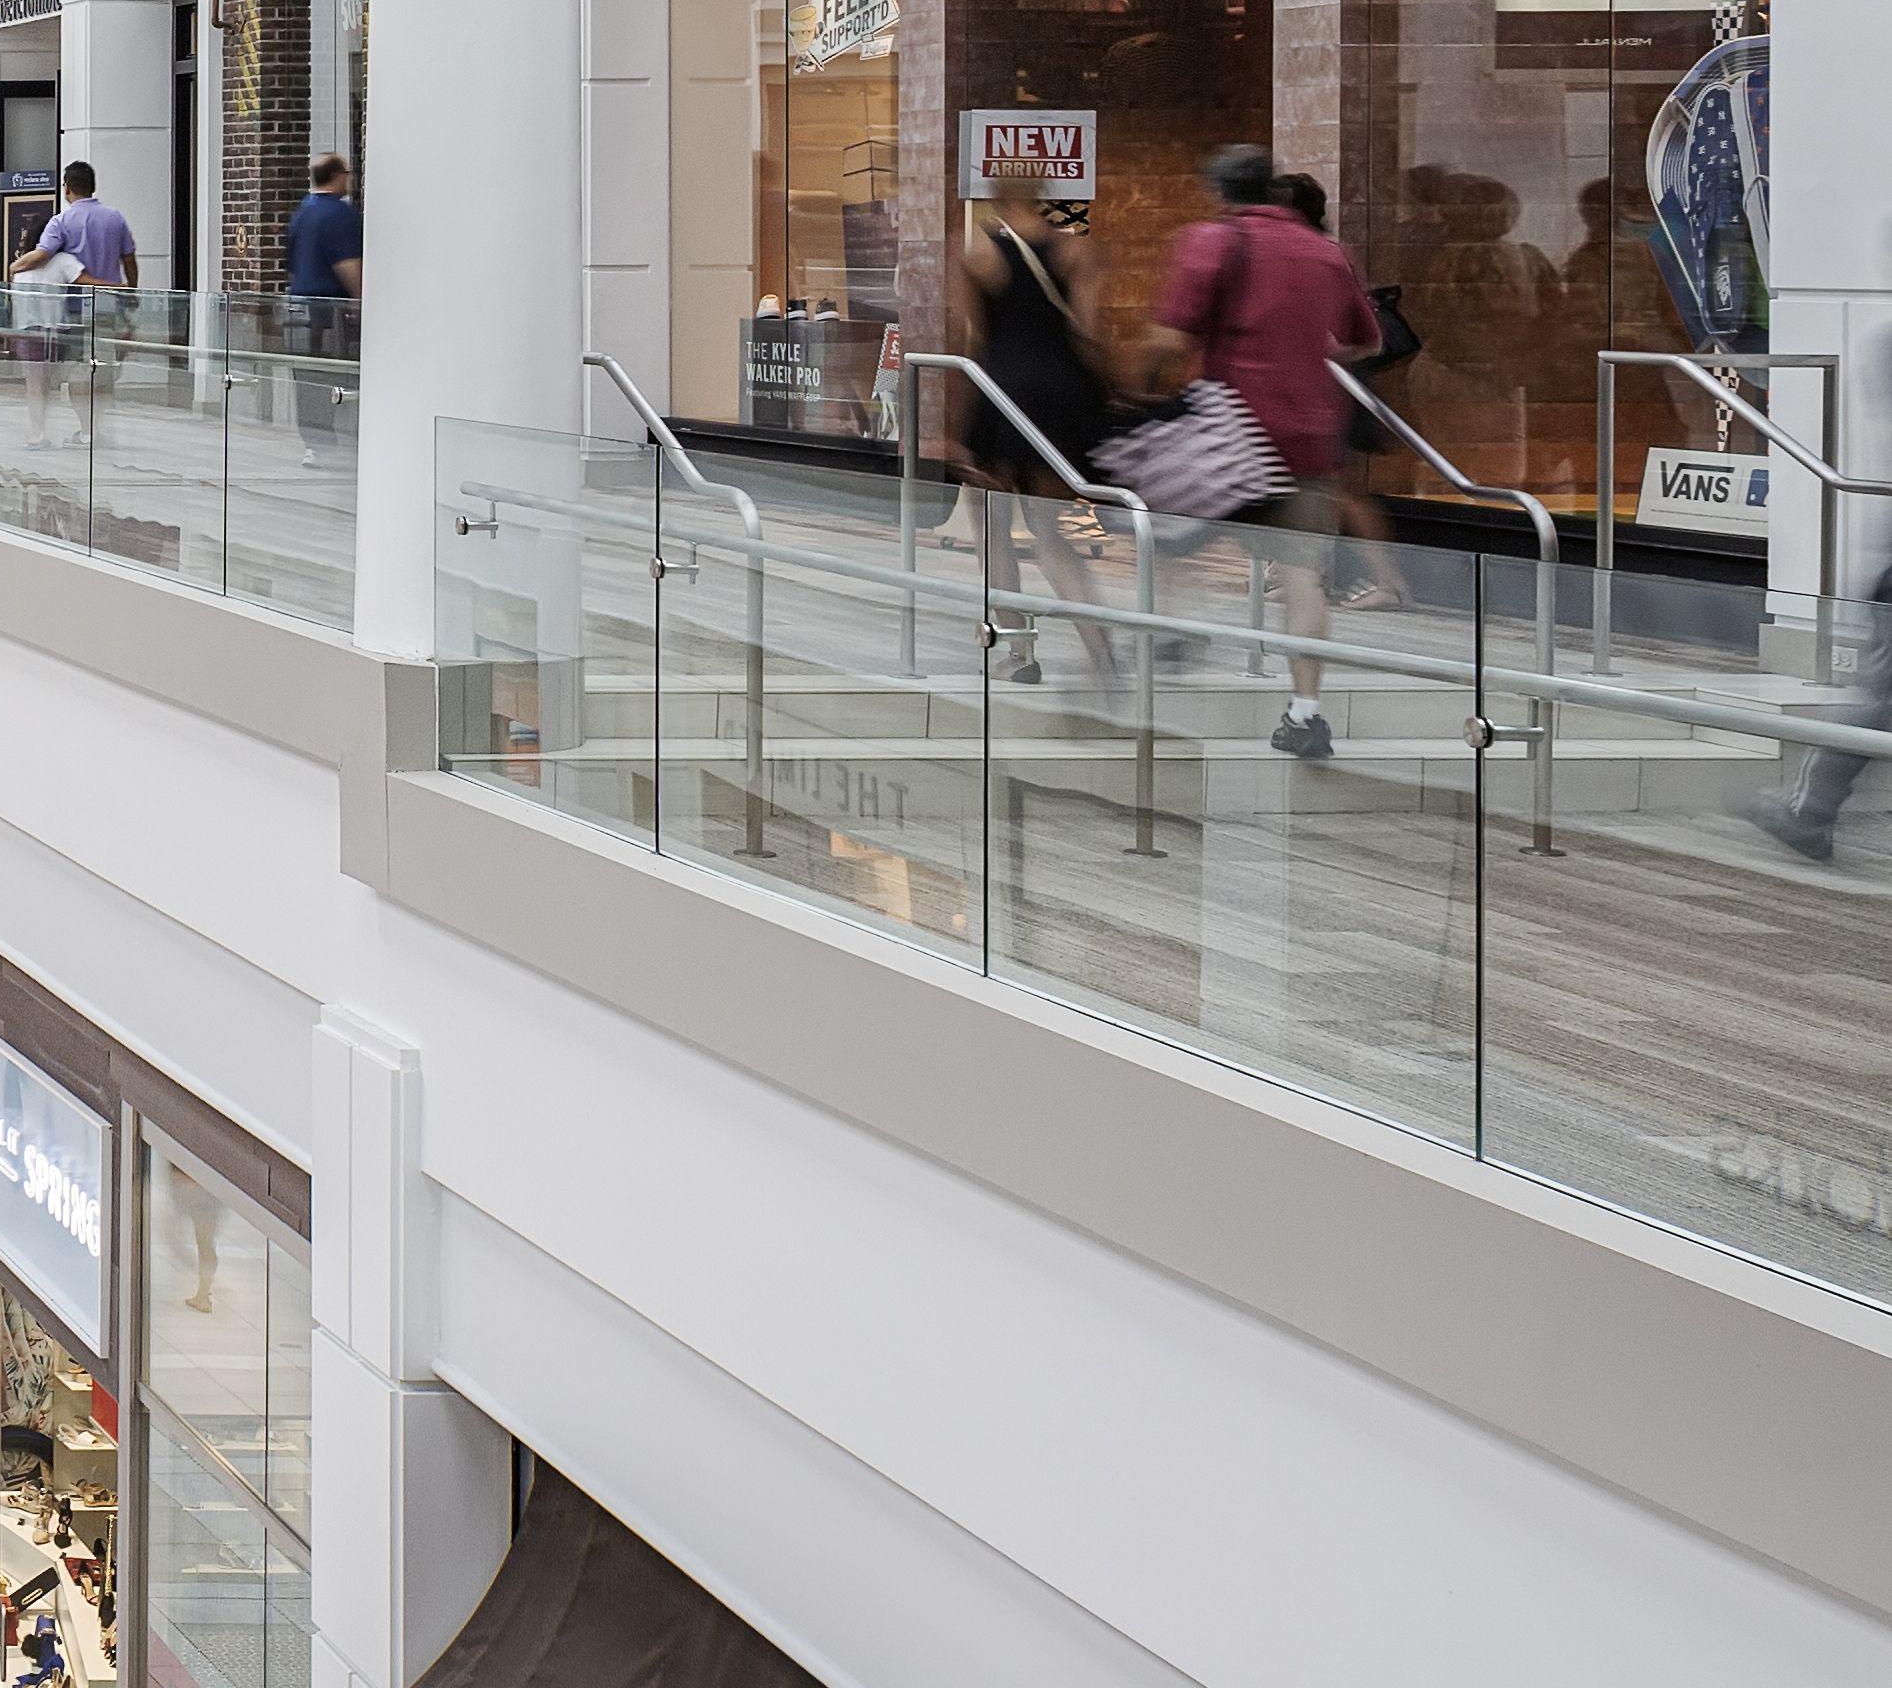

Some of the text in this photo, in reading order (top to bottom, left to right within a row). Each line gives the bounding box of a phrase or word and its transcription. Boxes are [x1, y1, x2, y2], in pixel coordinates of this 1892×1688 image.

[822, 0, 889, 54] SUPPORT'D
[991, 127, 1077, 157] NEW
[989, 161, 1079, 178] ARRIVALS
[746, 341, 801, 362] THE KYLE
[745, 363, 821, 387] WALKER PRO
[1661, 461, 1735, 503] VANS
[24, 1144, 101, 1257] SPRING
